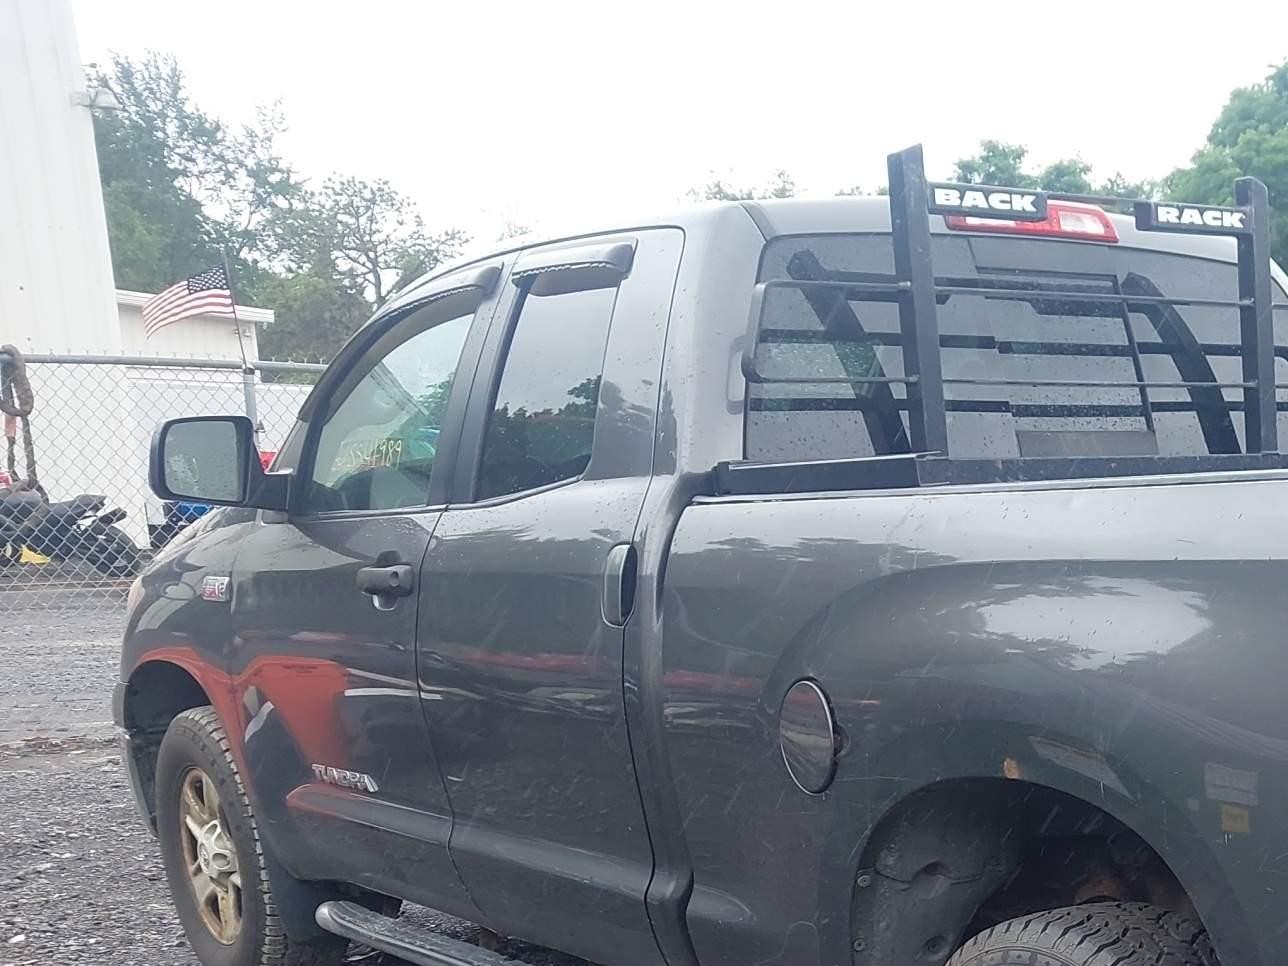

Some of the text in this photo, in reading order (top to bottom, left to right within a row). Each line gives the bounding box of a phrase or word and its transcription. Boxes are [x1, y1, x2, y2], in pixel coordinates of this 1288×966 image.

[934, 188, 1037, 213] BACK
[1157, 206, 1244, 229] RACK
[311, 763, 379, 793] TUNDRA
